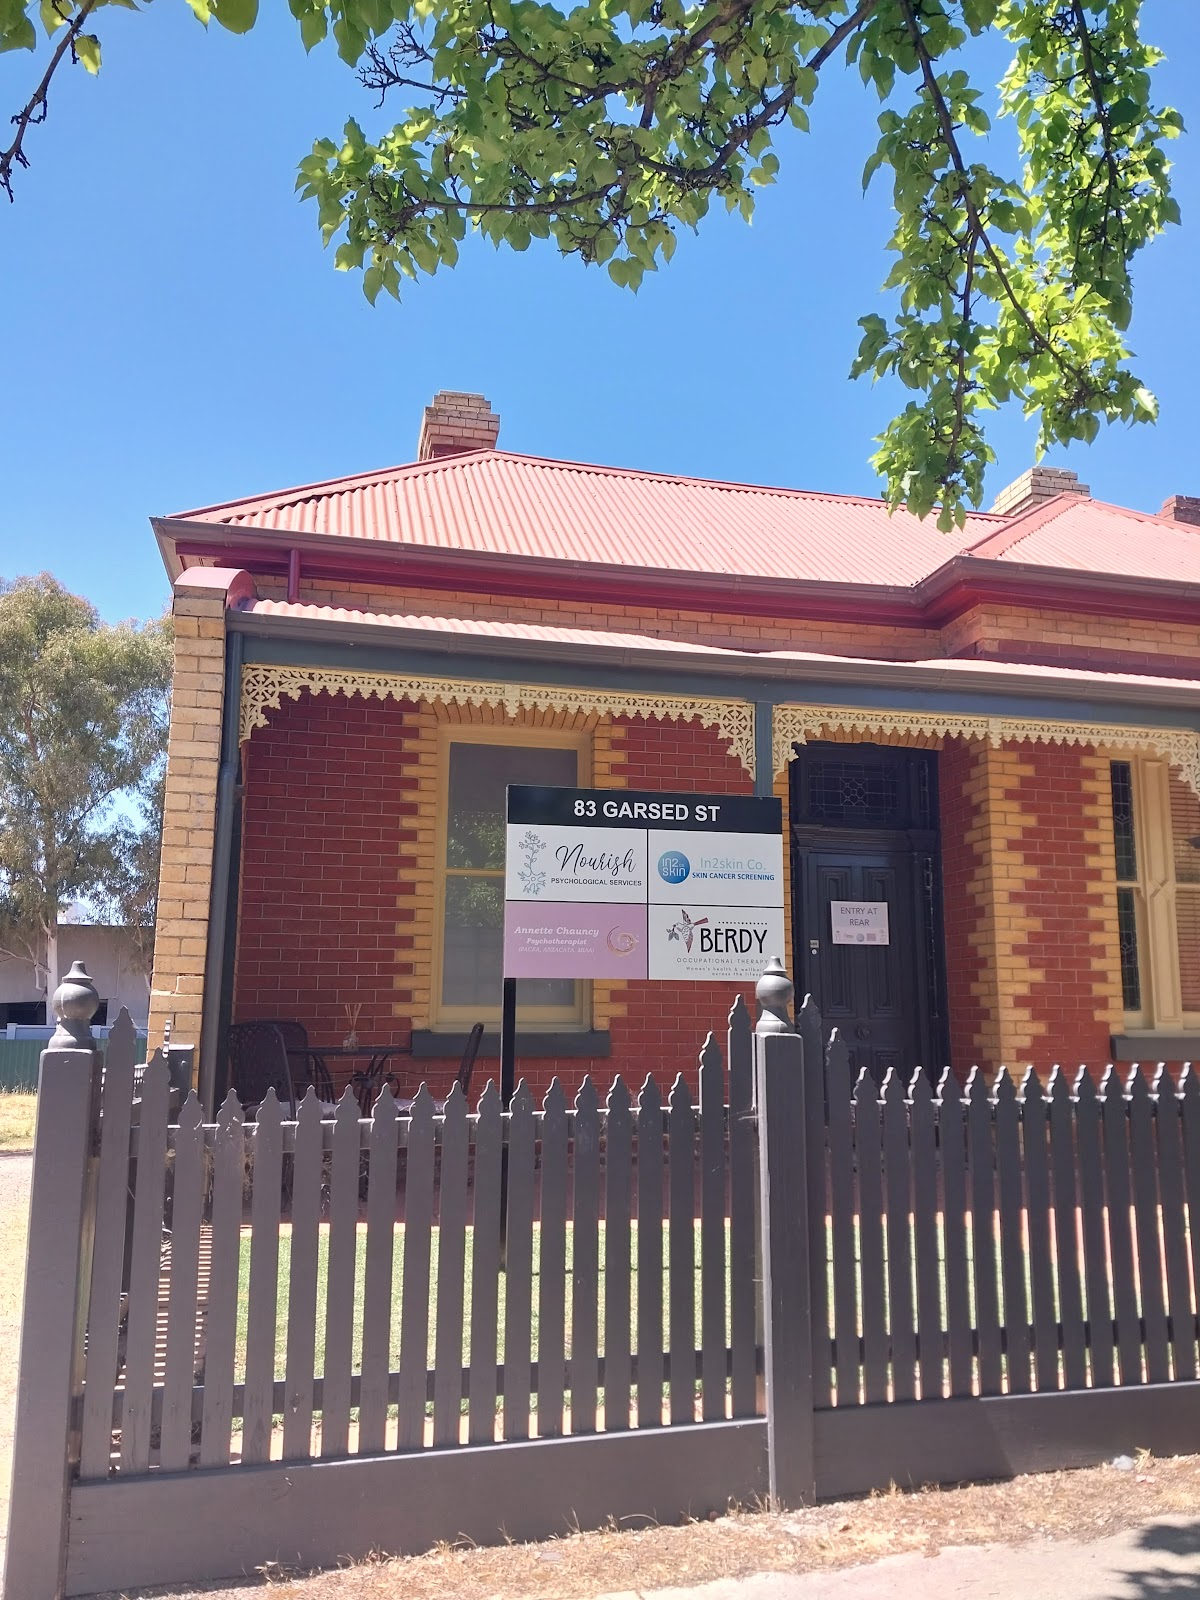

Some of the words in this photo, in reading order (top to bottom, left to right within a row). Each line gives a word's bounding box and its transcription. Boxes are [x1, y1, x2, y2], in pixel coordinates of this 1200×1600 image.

[573, 799, 597, 817] 83
[602, 800, 689, 821] GARSED
[694, 804, 721, 822] ST
[555, 843, 637, 877] Nourish
[700, 857, 743, 870] In2skin
[747, 859, 767, 871] Co.
[550, 878, 608, 886] PSYCHOLOGICAL
[710, 872, 736, 880] CANCER
[738, 873, 775, 881] SCREENING
[840, 907, 866, 915] ENTRY
[514, 926, 554, 935] Annette
[556, 926, 600, 938] Chauncy
[526, 938, 587, 946] Psychotherapist
[700, 928, 768, 954] BERDY
